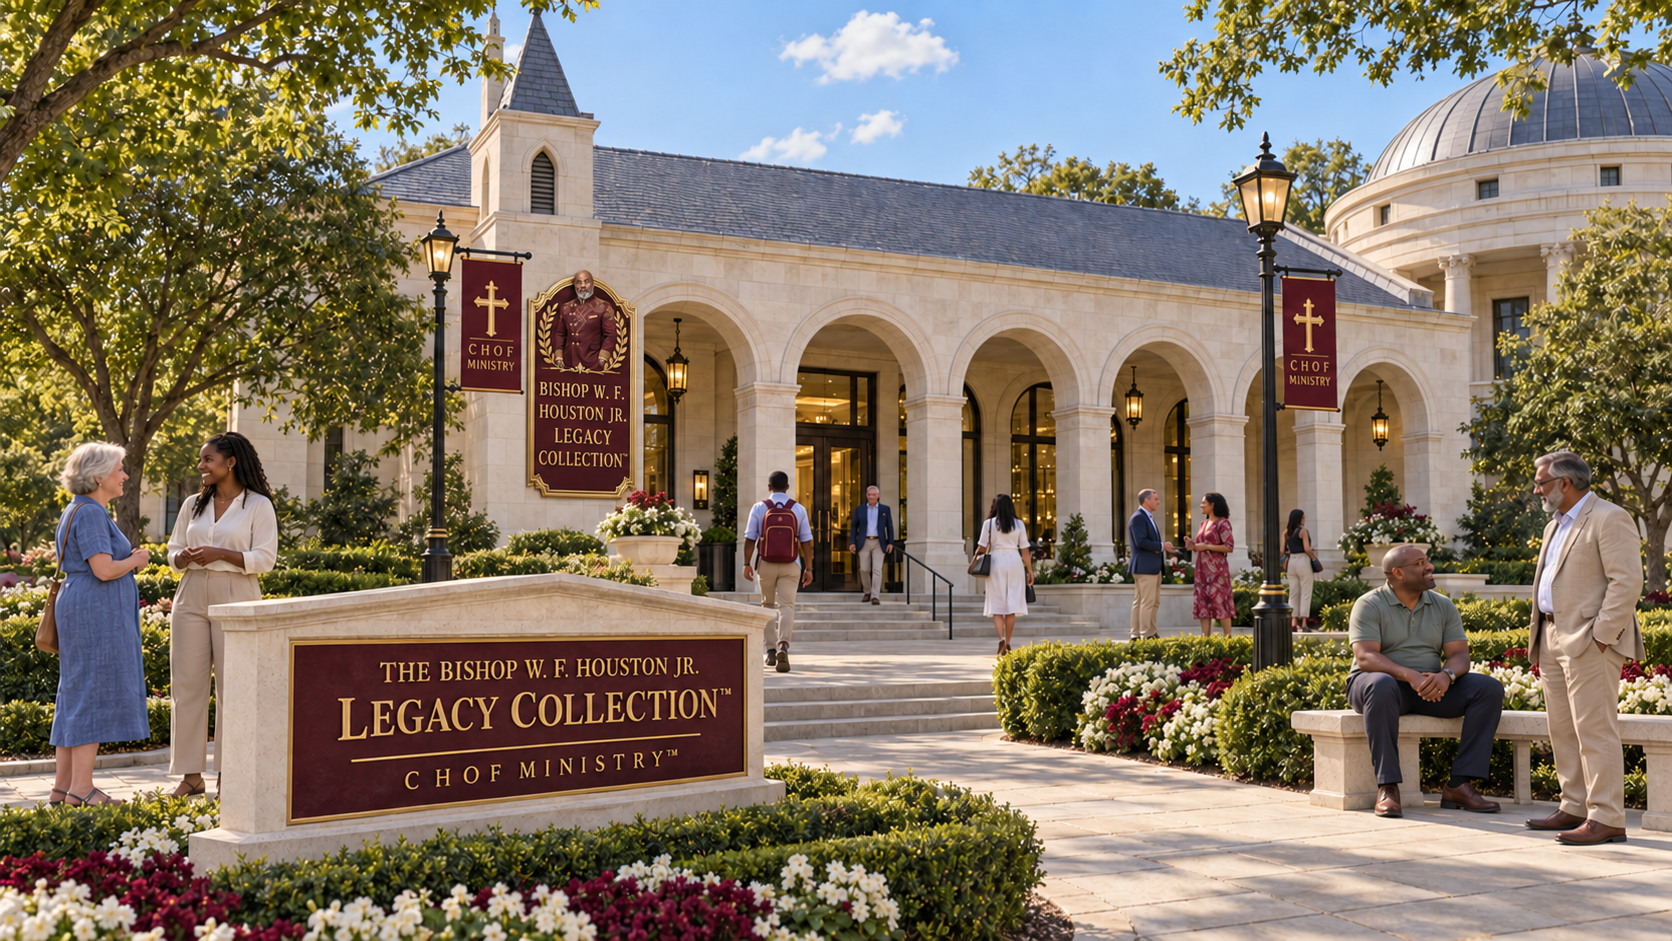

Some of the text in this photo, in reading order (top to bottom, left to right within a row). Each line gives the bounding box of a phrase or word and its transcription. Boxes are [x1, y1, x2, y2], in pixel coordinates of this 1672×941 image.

[467, 358, 515, 372] MINISTRY
[1289, 374, 1331, 387] MINISTRY
[539, 381, 625, 401] BISHOP W. F.
[538, 403, 628, 424] HOUSTON JR.
[554, 427, 613, 446] LEGACY
[380, 656, 699, 684] THE BISHOP W. F. HOUSTON JR.
[337, 696, 500, 741] LEGACY
